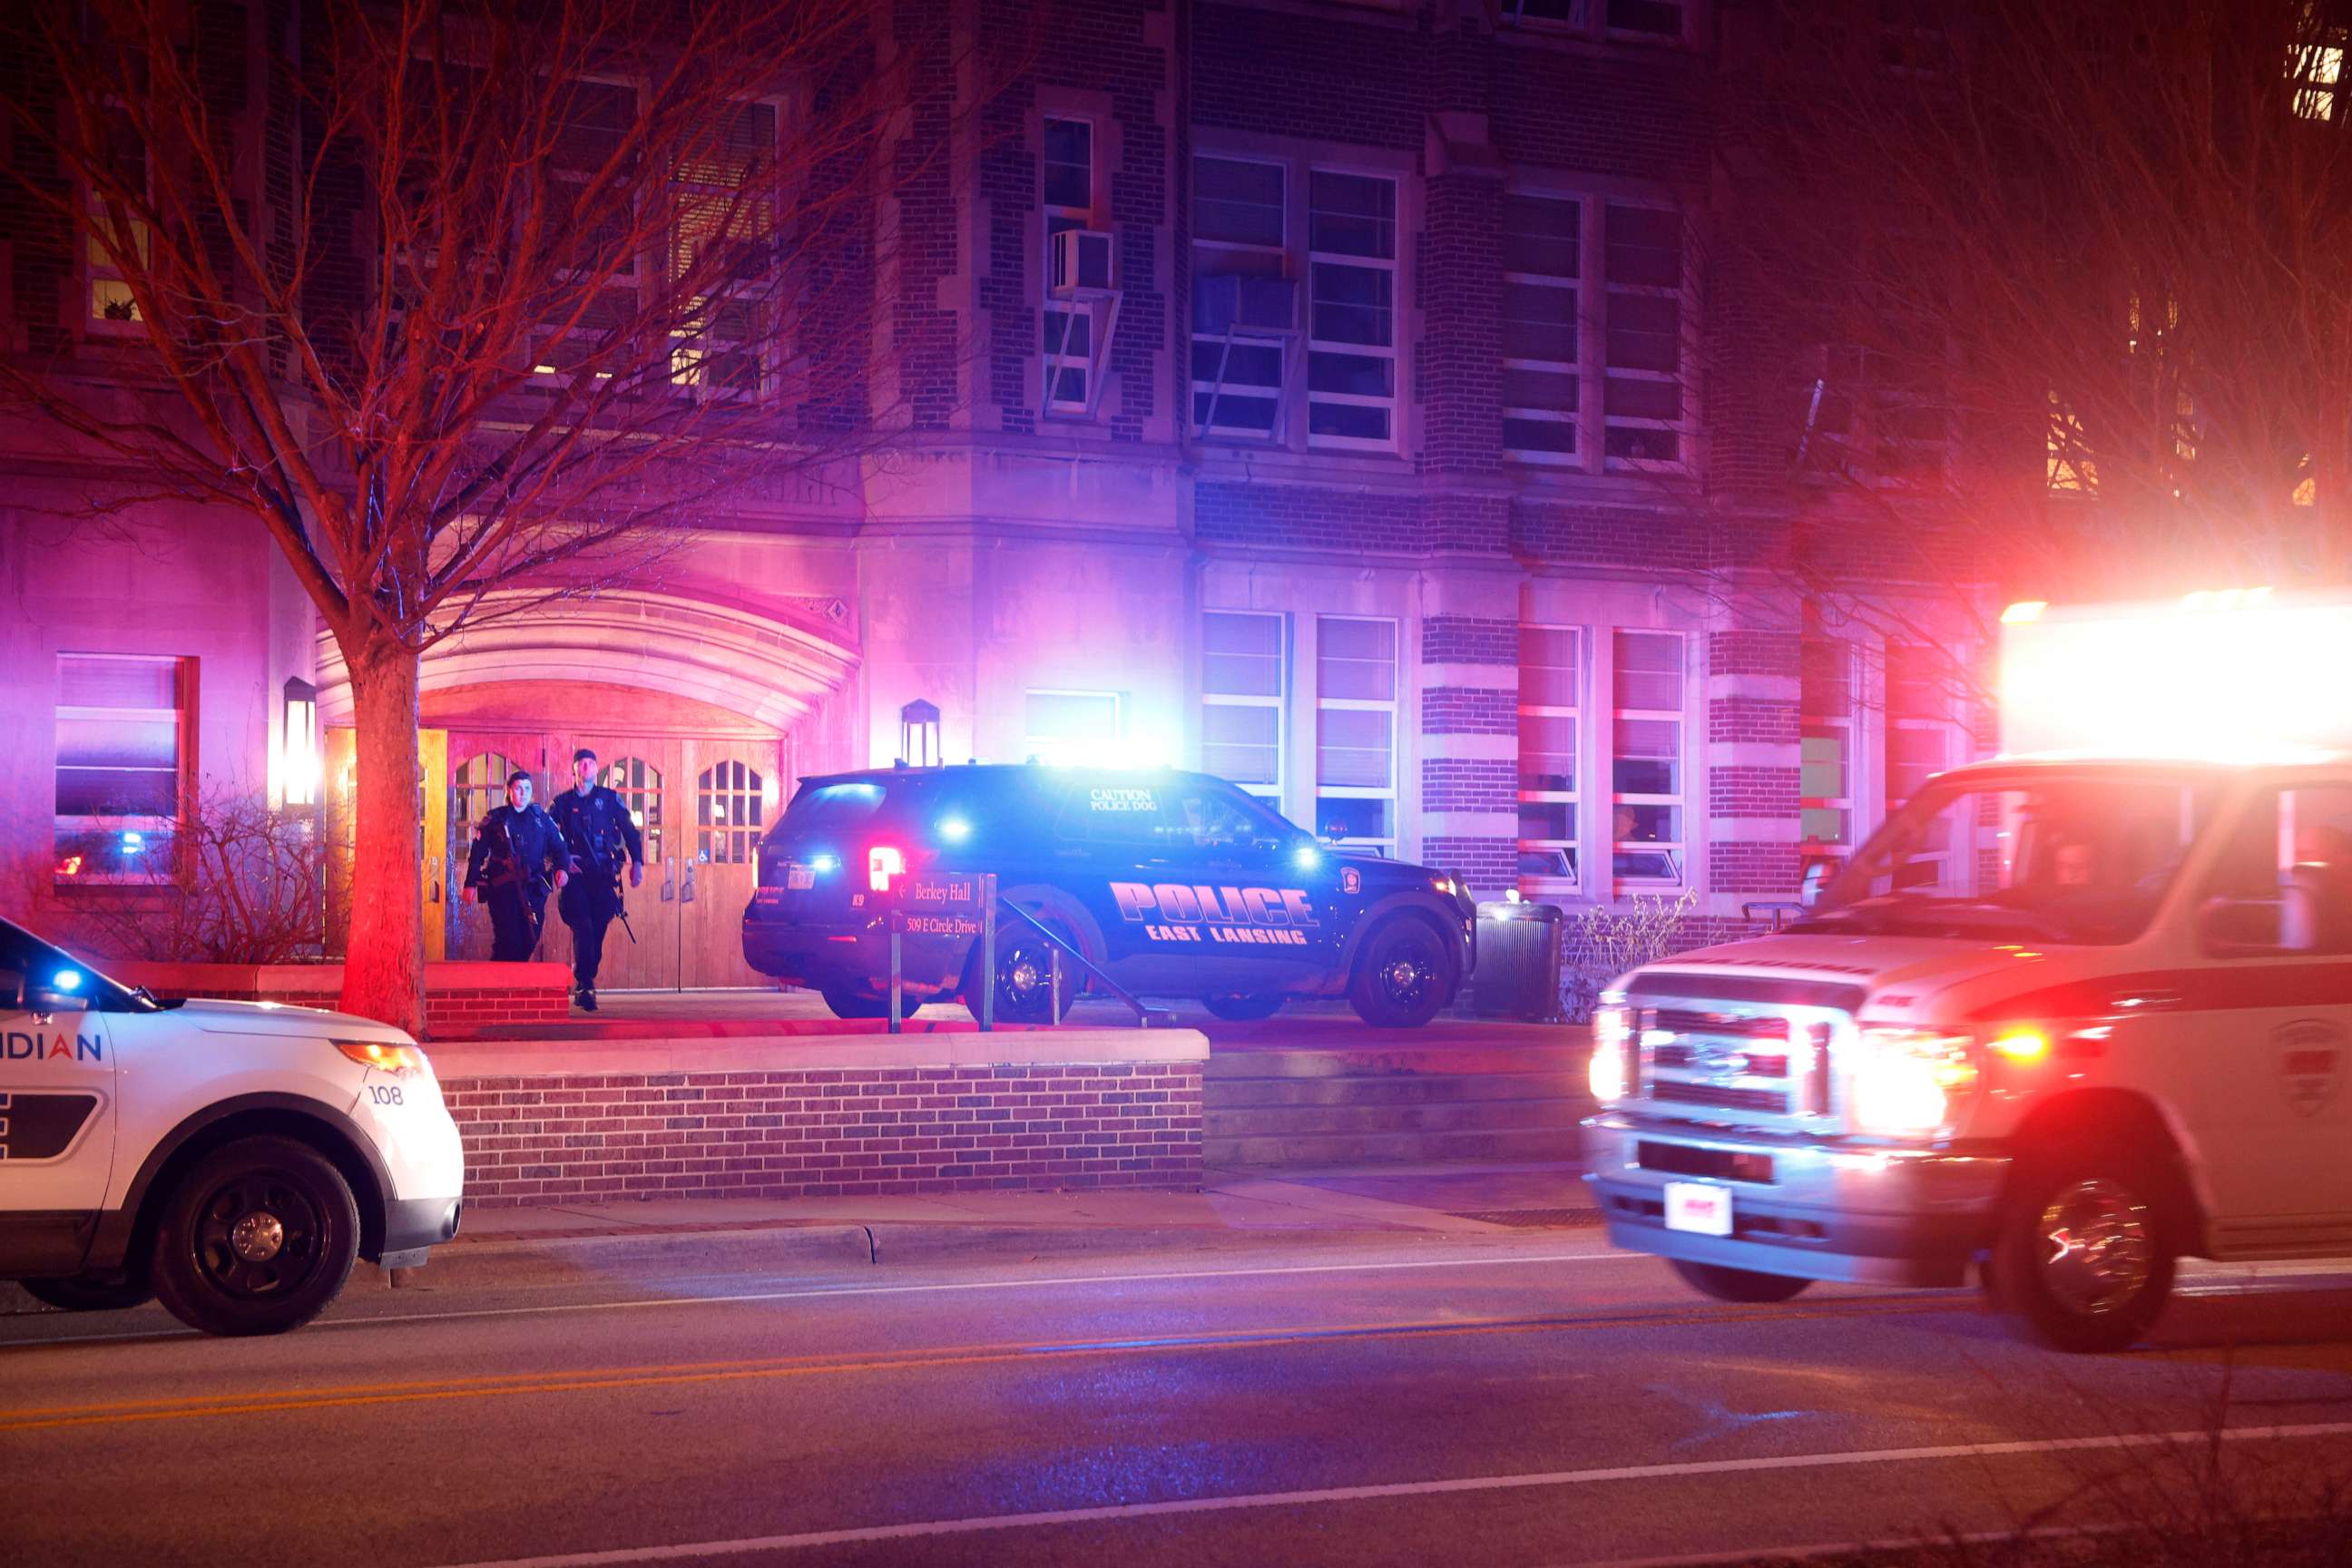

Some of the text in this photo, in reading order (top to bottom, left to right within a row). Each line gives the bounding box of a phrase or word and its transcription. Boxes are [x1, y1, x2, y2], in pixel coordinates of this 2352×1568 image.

[1091, 789, 1151, 800] CAUTION
[1090, 800, 1157, 811] POLICE DOG
[852, 894, 865, 906] K9
[915, 881, 971, 905] Berkey Hall
[1109, 882, 1319, 927] POLICE
[906, 916, 976, 934] 509 E Circle Drive
[1145, 925, 1308, 945] EAST LANSING
[368, 1085, 404, 1105] 108
